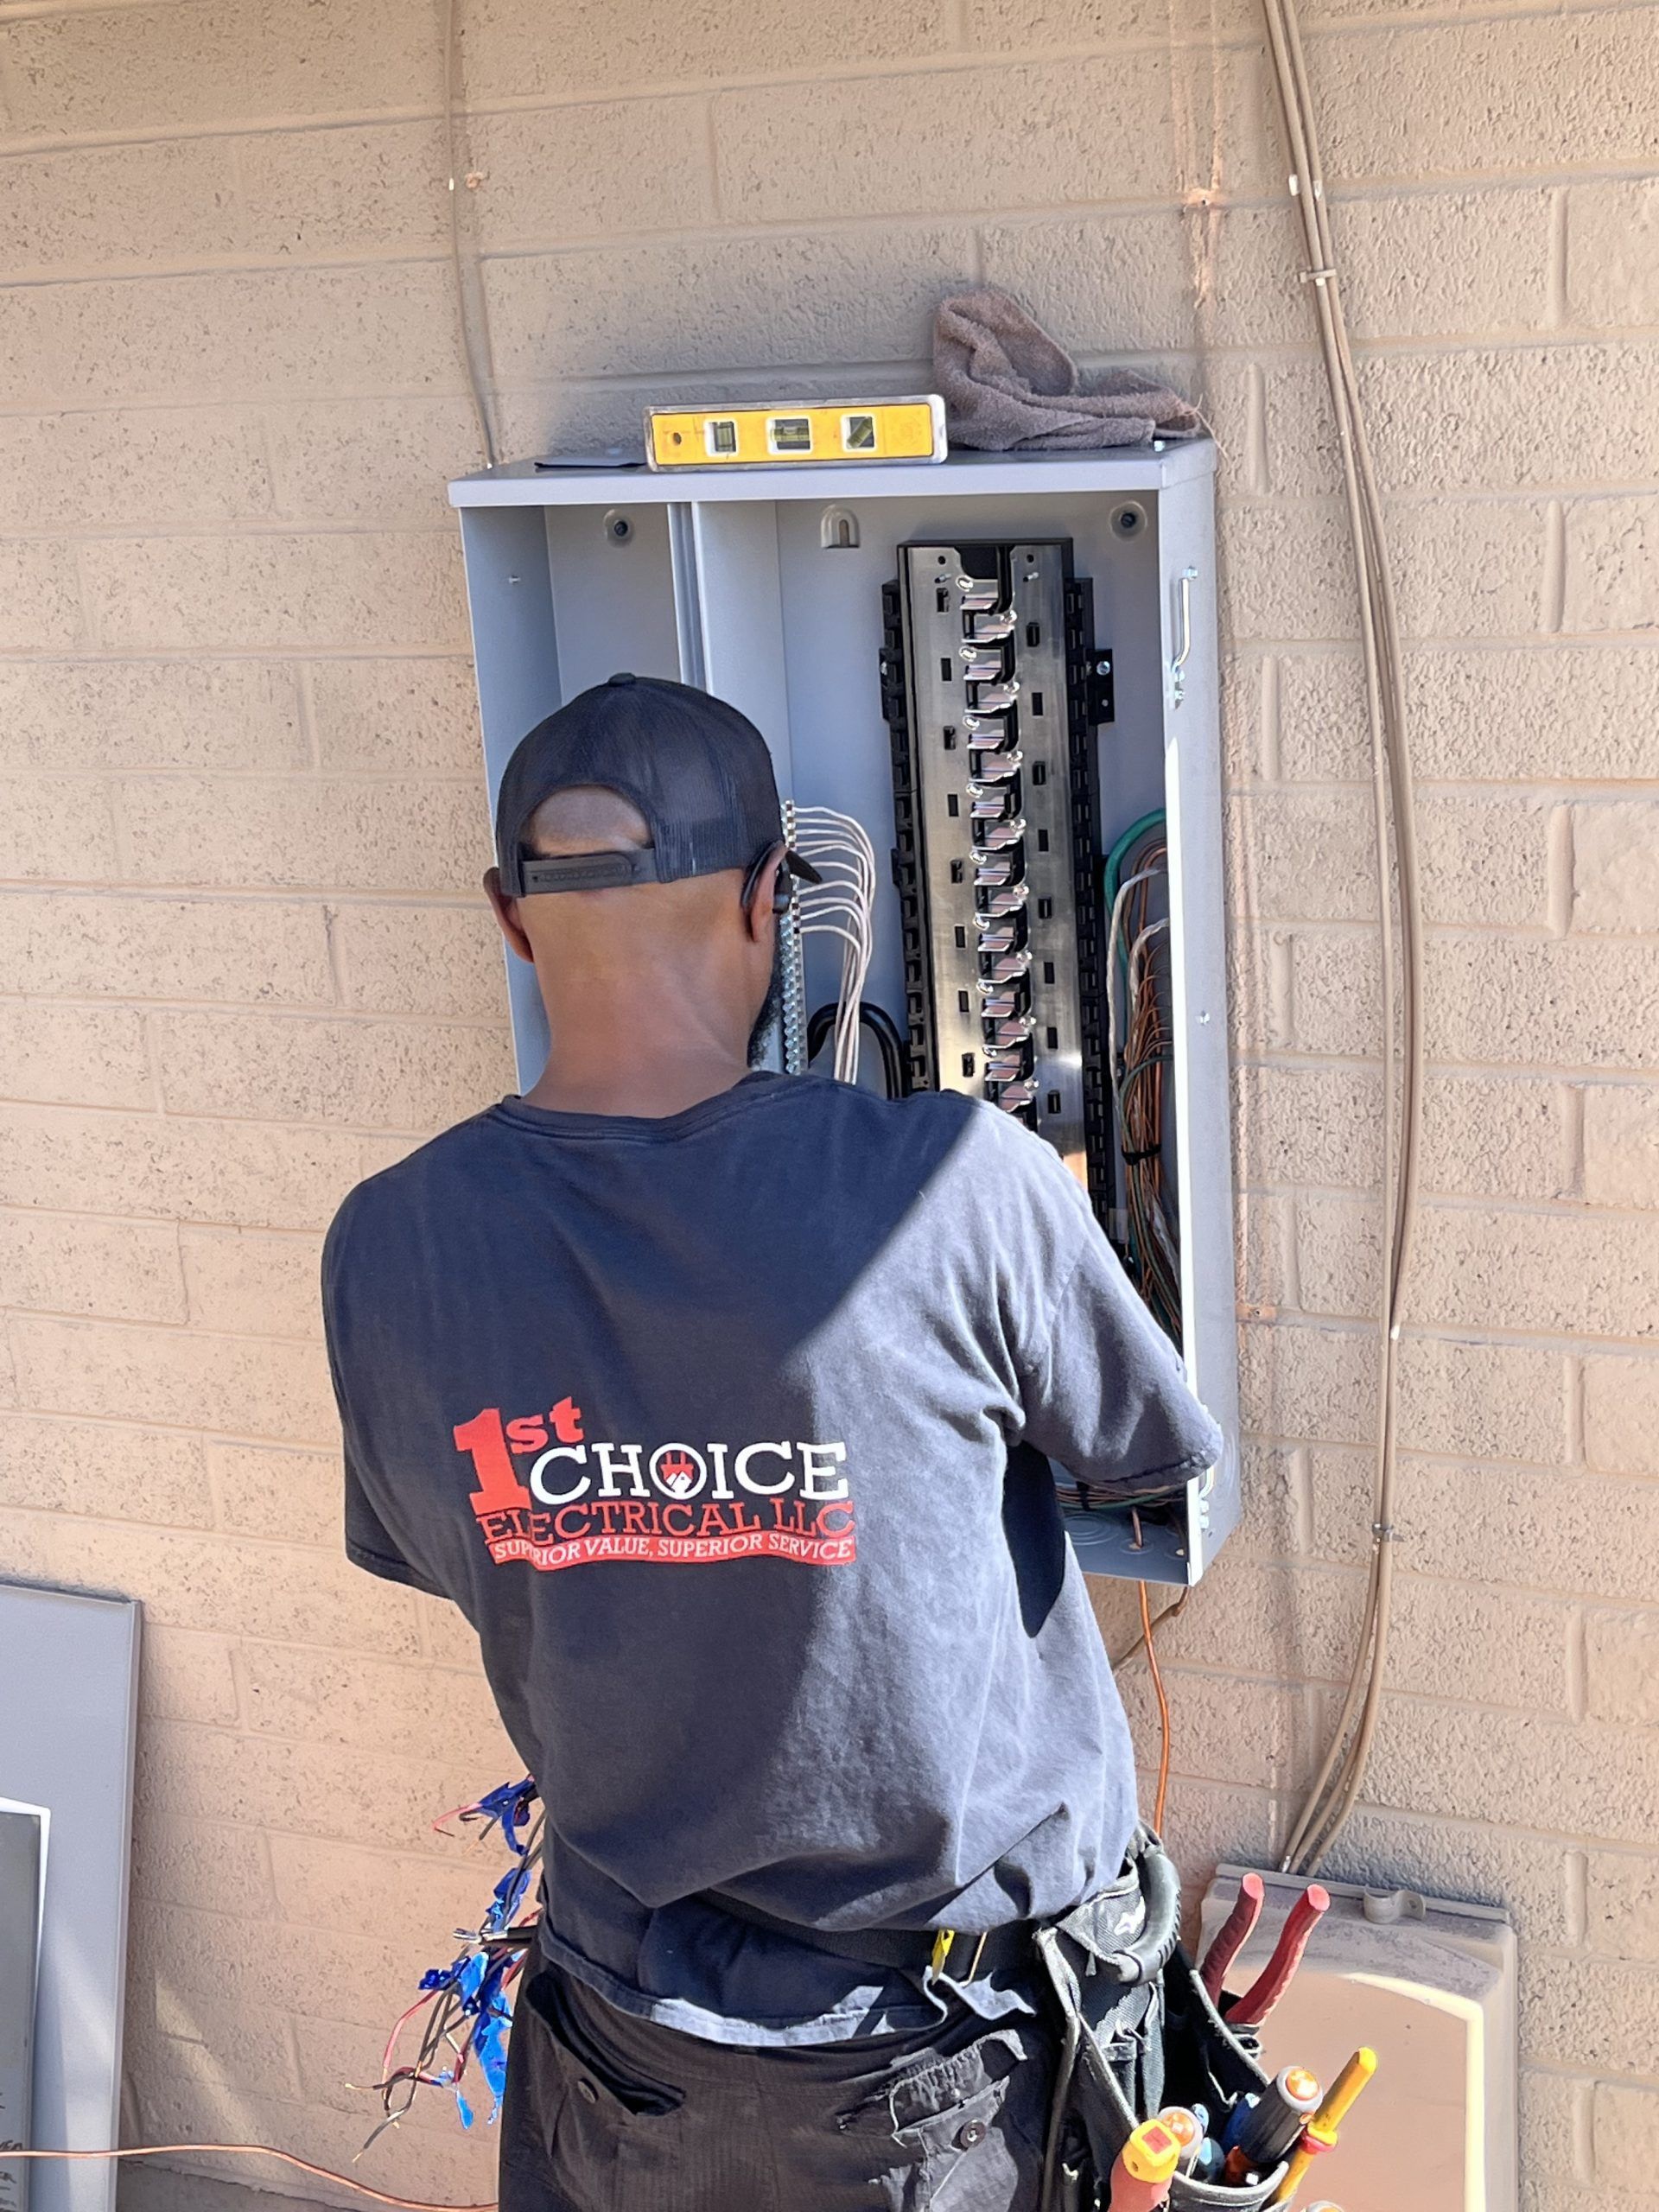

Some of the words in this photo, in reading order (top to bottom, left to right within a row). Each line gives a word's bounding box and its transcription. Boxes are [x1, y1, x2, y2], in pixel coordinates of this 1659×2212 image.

[453, 1396, 585, 1515] 1st
[530, 1440, 849, 1505] CHOICE
[475, 1501, 761, 1546] ELECTRICAL
[769, 1497, 855, 1538] LLC
[494, 1540, 581, 1567] SUPRIOR
[583, 1535, 654, 1558] VALUE,
[657, 1533, 763, 1558] SUPERIOR
[768, 1533, 853, 1560] SERVICE
